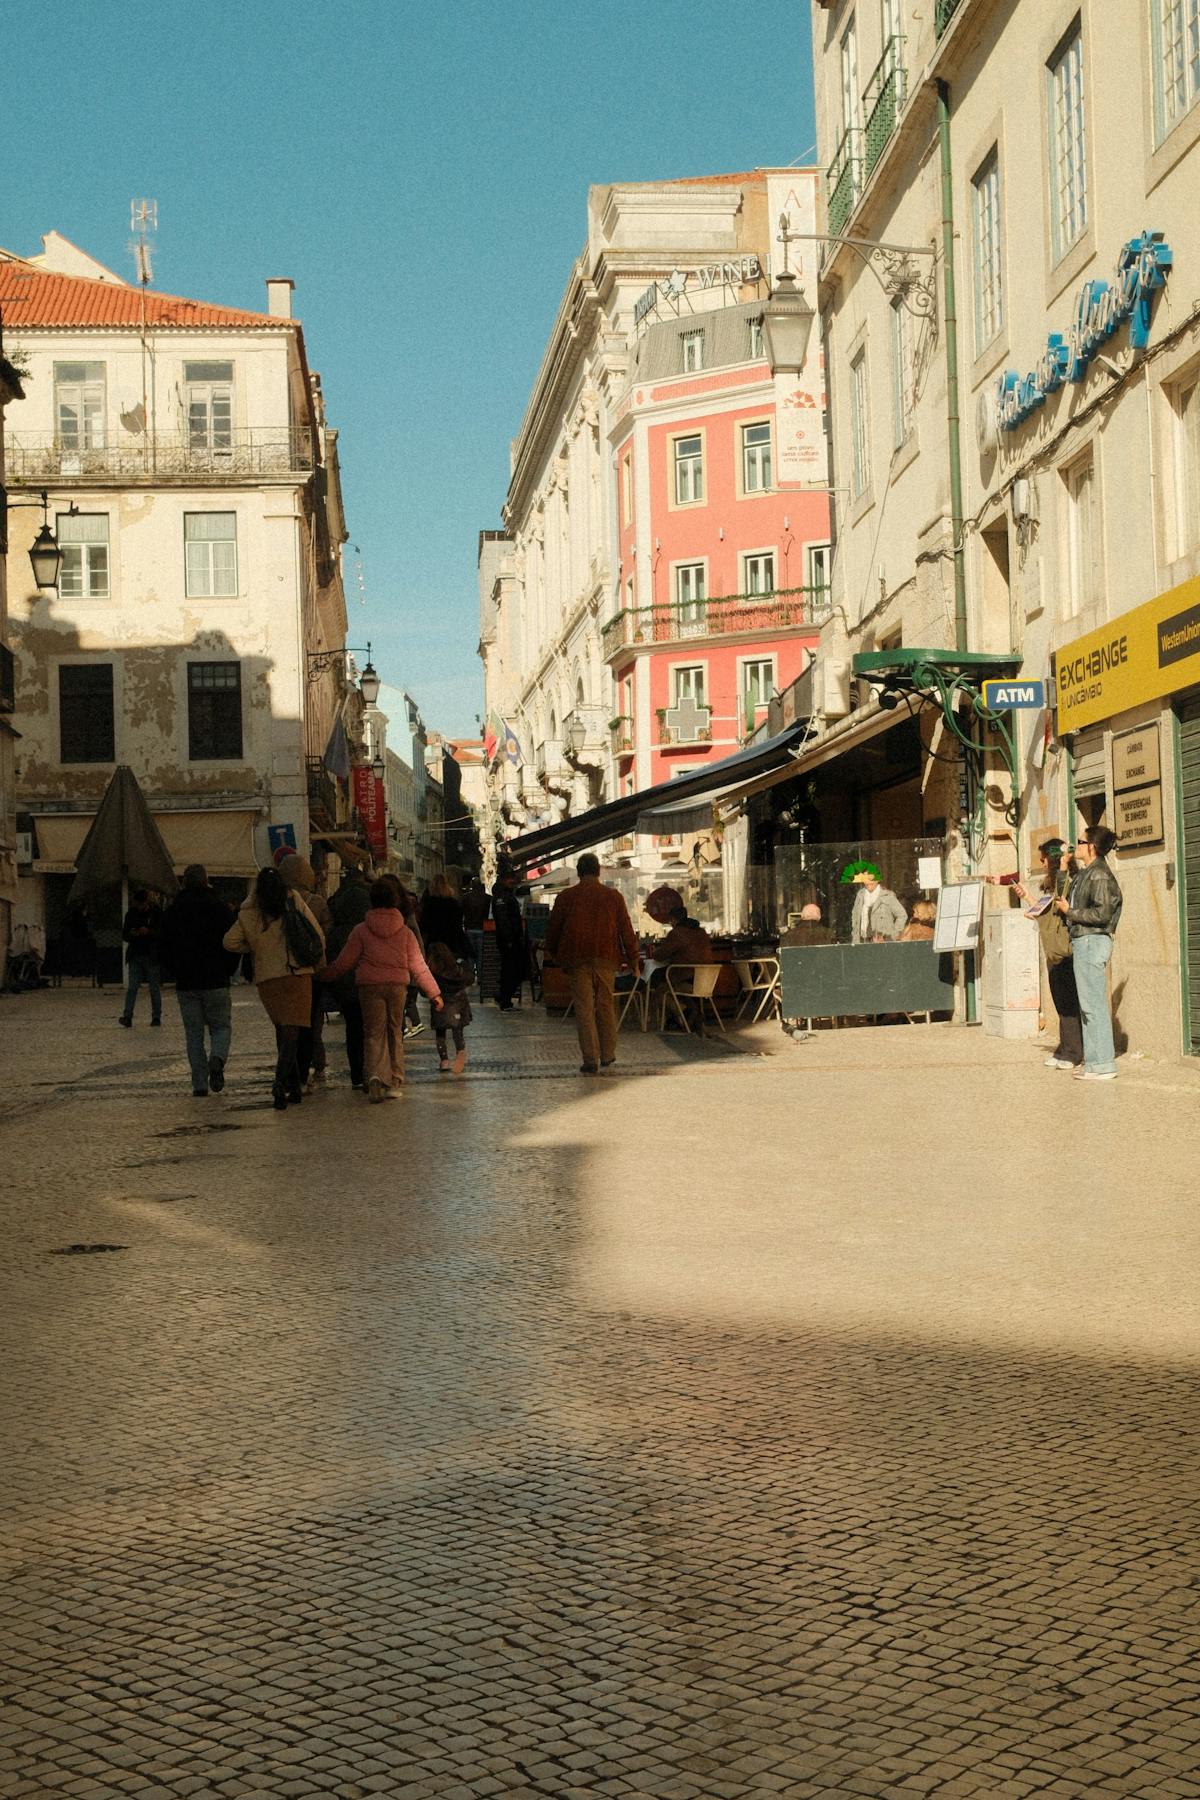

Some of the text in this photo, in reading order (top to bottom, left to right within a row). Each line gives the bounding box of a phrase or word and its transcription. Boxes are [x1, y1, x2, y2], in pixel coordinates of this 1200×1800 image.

[695, 255, 760, 290] WINE
[1060, 636, 1128, 691] EXCHANGE
[995, 687, 1034, 703] ATM
[1126, 765, 1145, 779] EXCHANGE
[1134, 825, 1153, 837] TRANSFER
